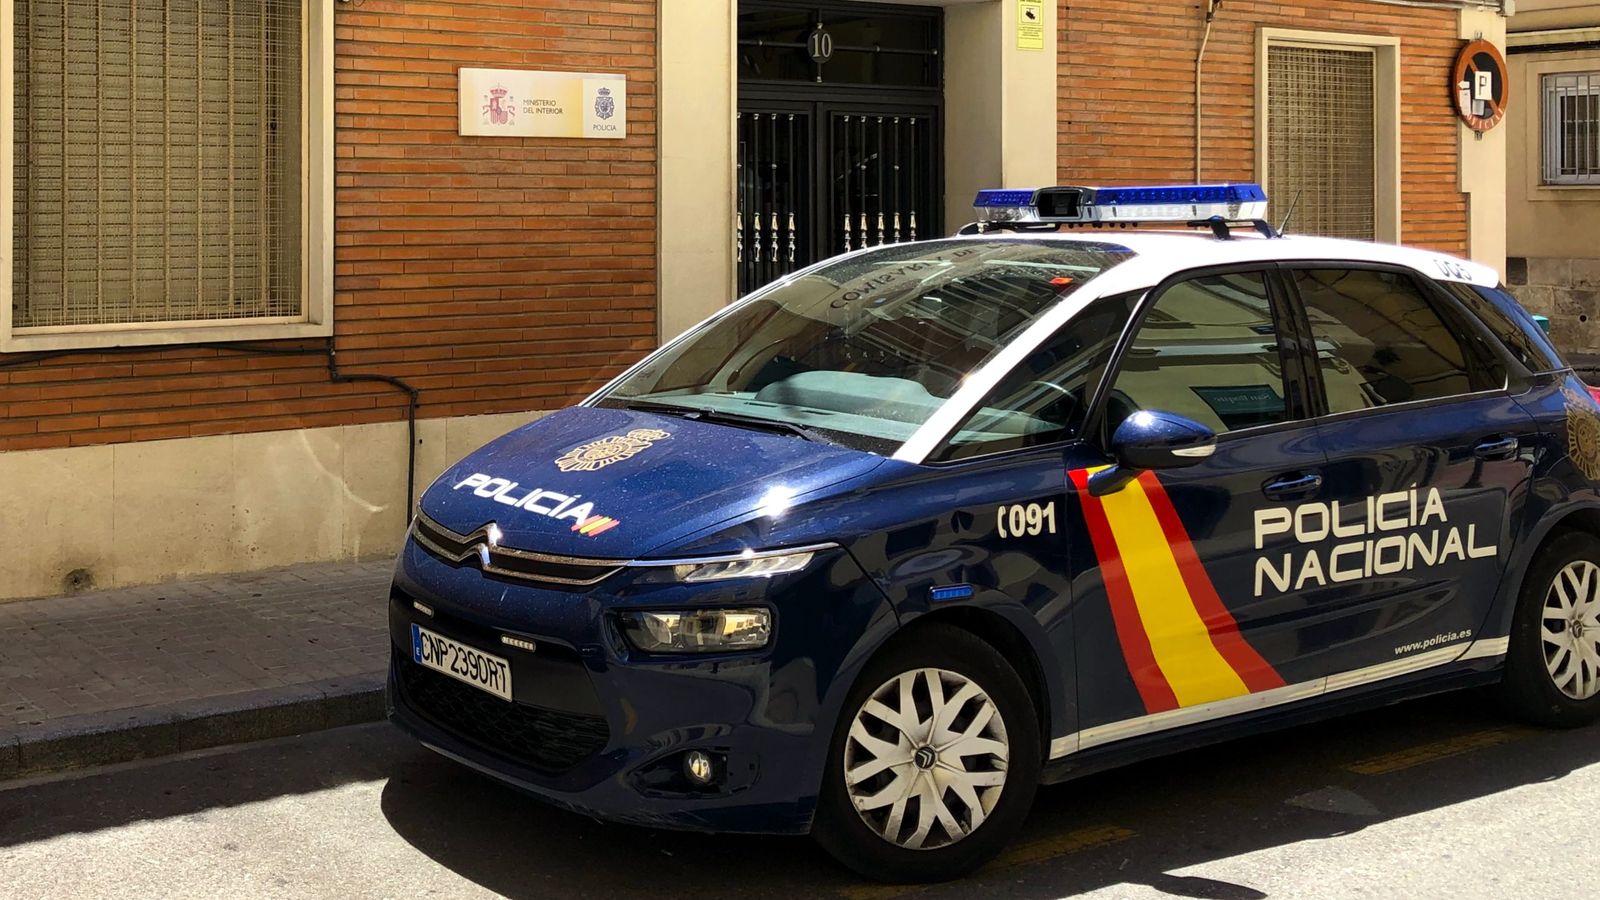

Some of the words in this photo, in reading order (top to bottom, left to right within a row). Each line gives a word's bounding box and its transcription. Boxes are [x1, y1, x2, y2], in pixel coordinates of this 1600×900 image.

[812, 33, 832, 58] 10
[1478, 75, 1488, 97] P
[522, 99, 557, 107] MINISTERIO
[522, 106, 535, 114] DEL
[535, 107, 563, 115] INTERIOR
[452, 472, 594, 526] POLICÍA
[1008, 501, 1057, 537] 091
[1254, 482, 1448, 549] POLICÍA
[1254, 523, 1498, 597] NACIONAL
[1394, 629, 1472, 655] www.policia.es
[420, 631, 507, 694] CNP2390RT
